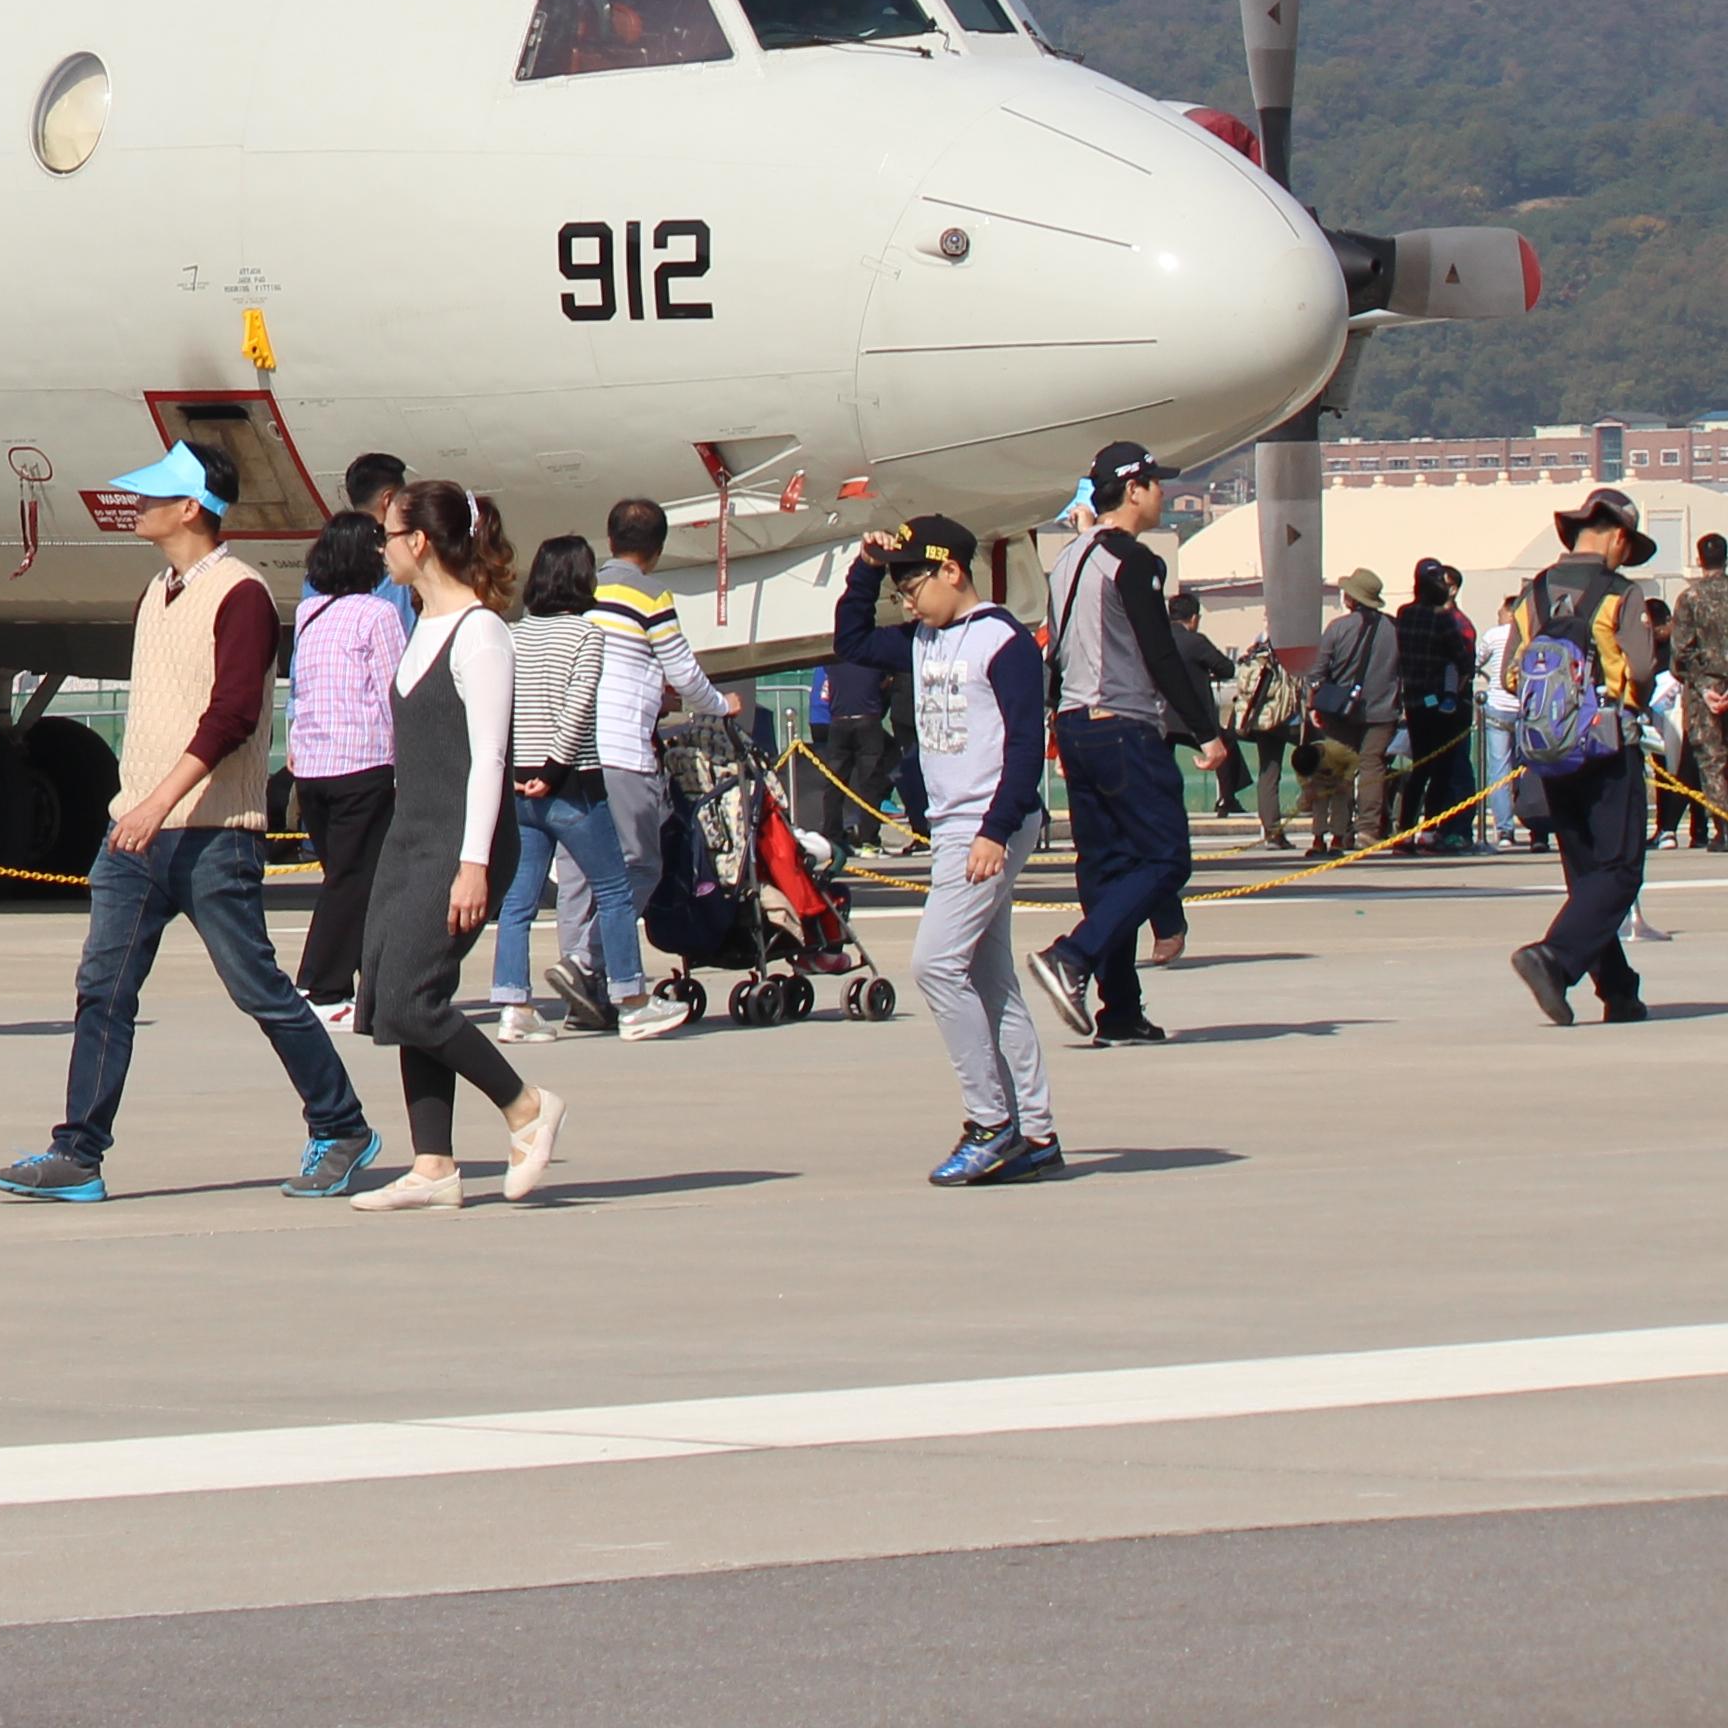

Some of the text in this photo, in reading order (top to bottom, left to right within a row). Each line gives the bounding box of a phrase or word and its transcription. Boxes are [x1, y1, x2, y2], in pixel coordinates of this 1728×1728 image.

[558, 220, 713, 321] 912
[96, 494, 141, 505] WARNIN
[925, 544, 950, 562] 1932
